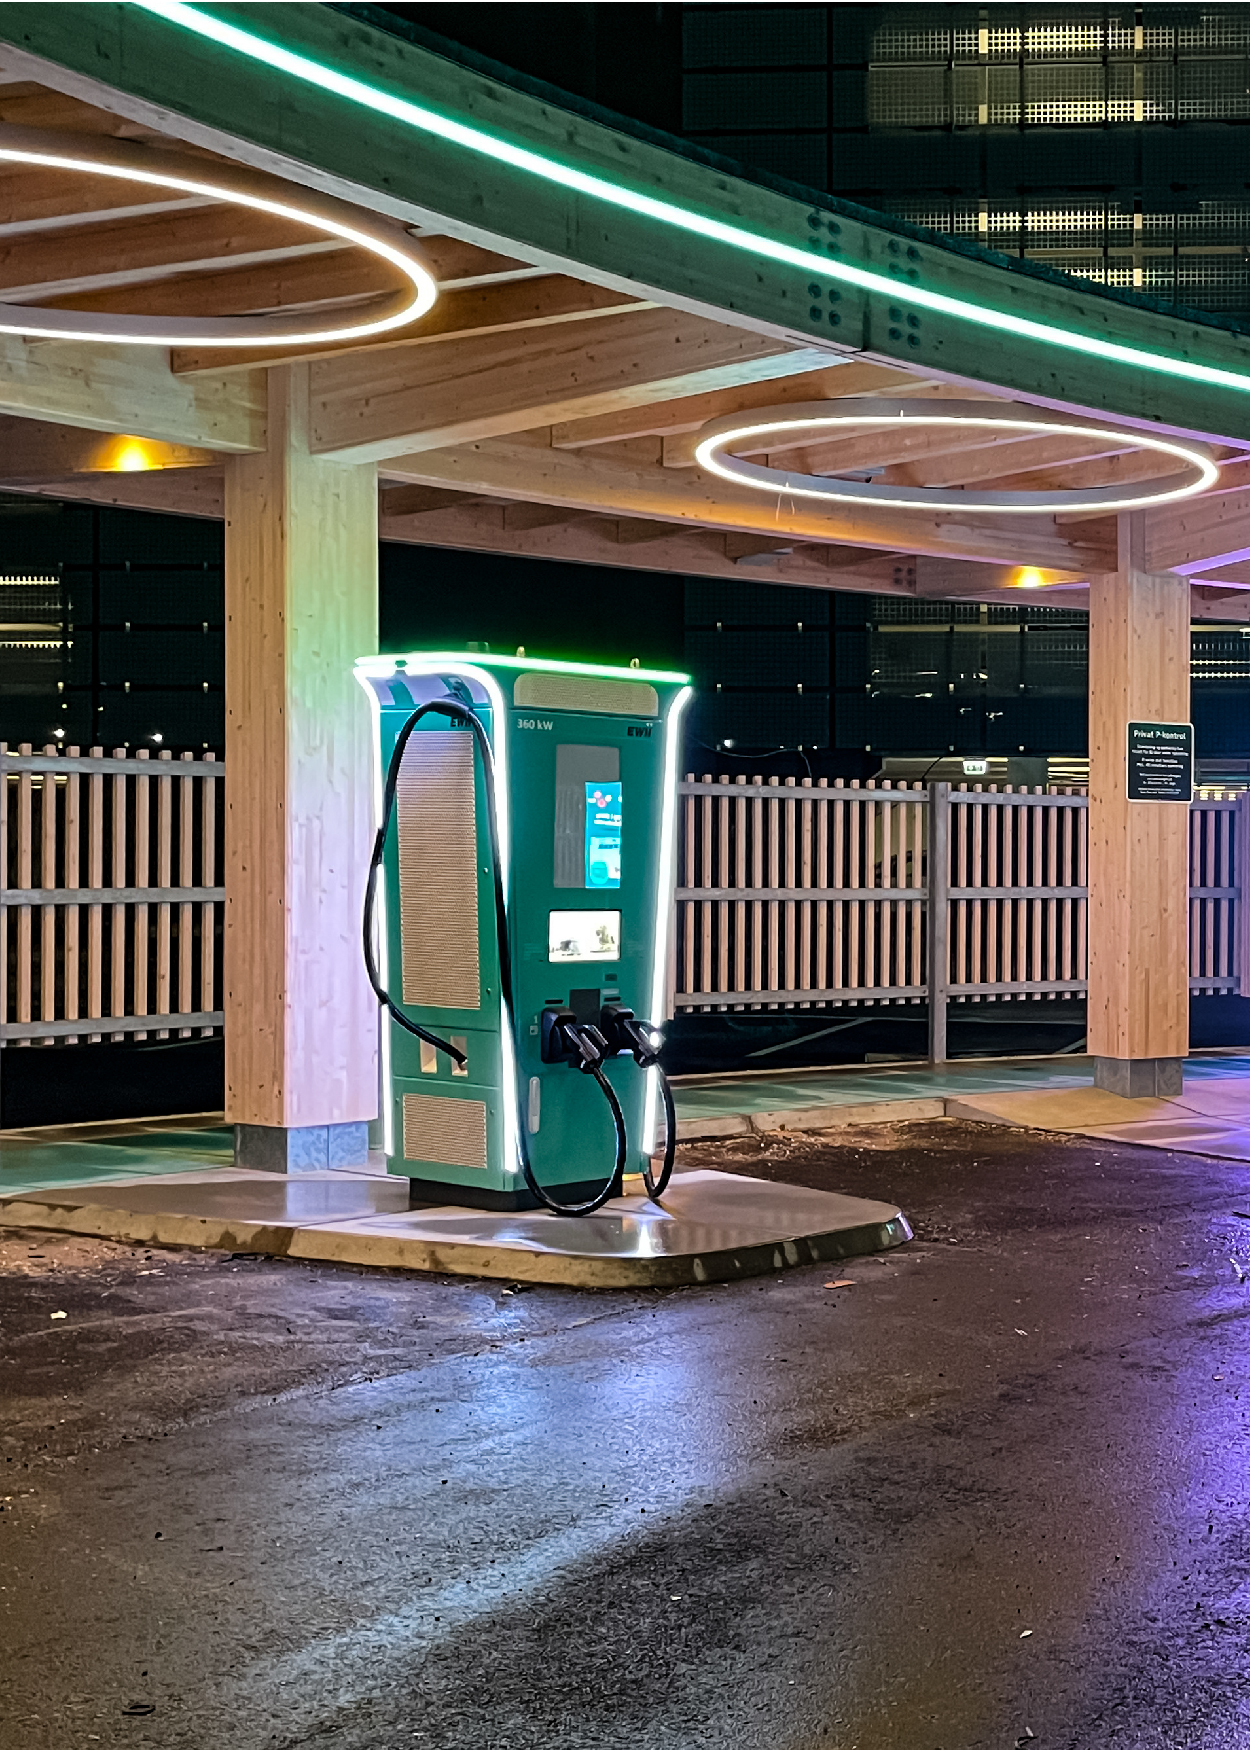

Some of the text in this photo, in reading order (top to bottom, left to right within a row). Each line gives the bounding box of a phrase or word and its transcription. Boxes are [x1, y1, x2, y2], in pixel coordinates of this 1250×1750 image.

[517, 719, 553, 731] 360 kW
[1133, 729, 1154, 739] Privat
